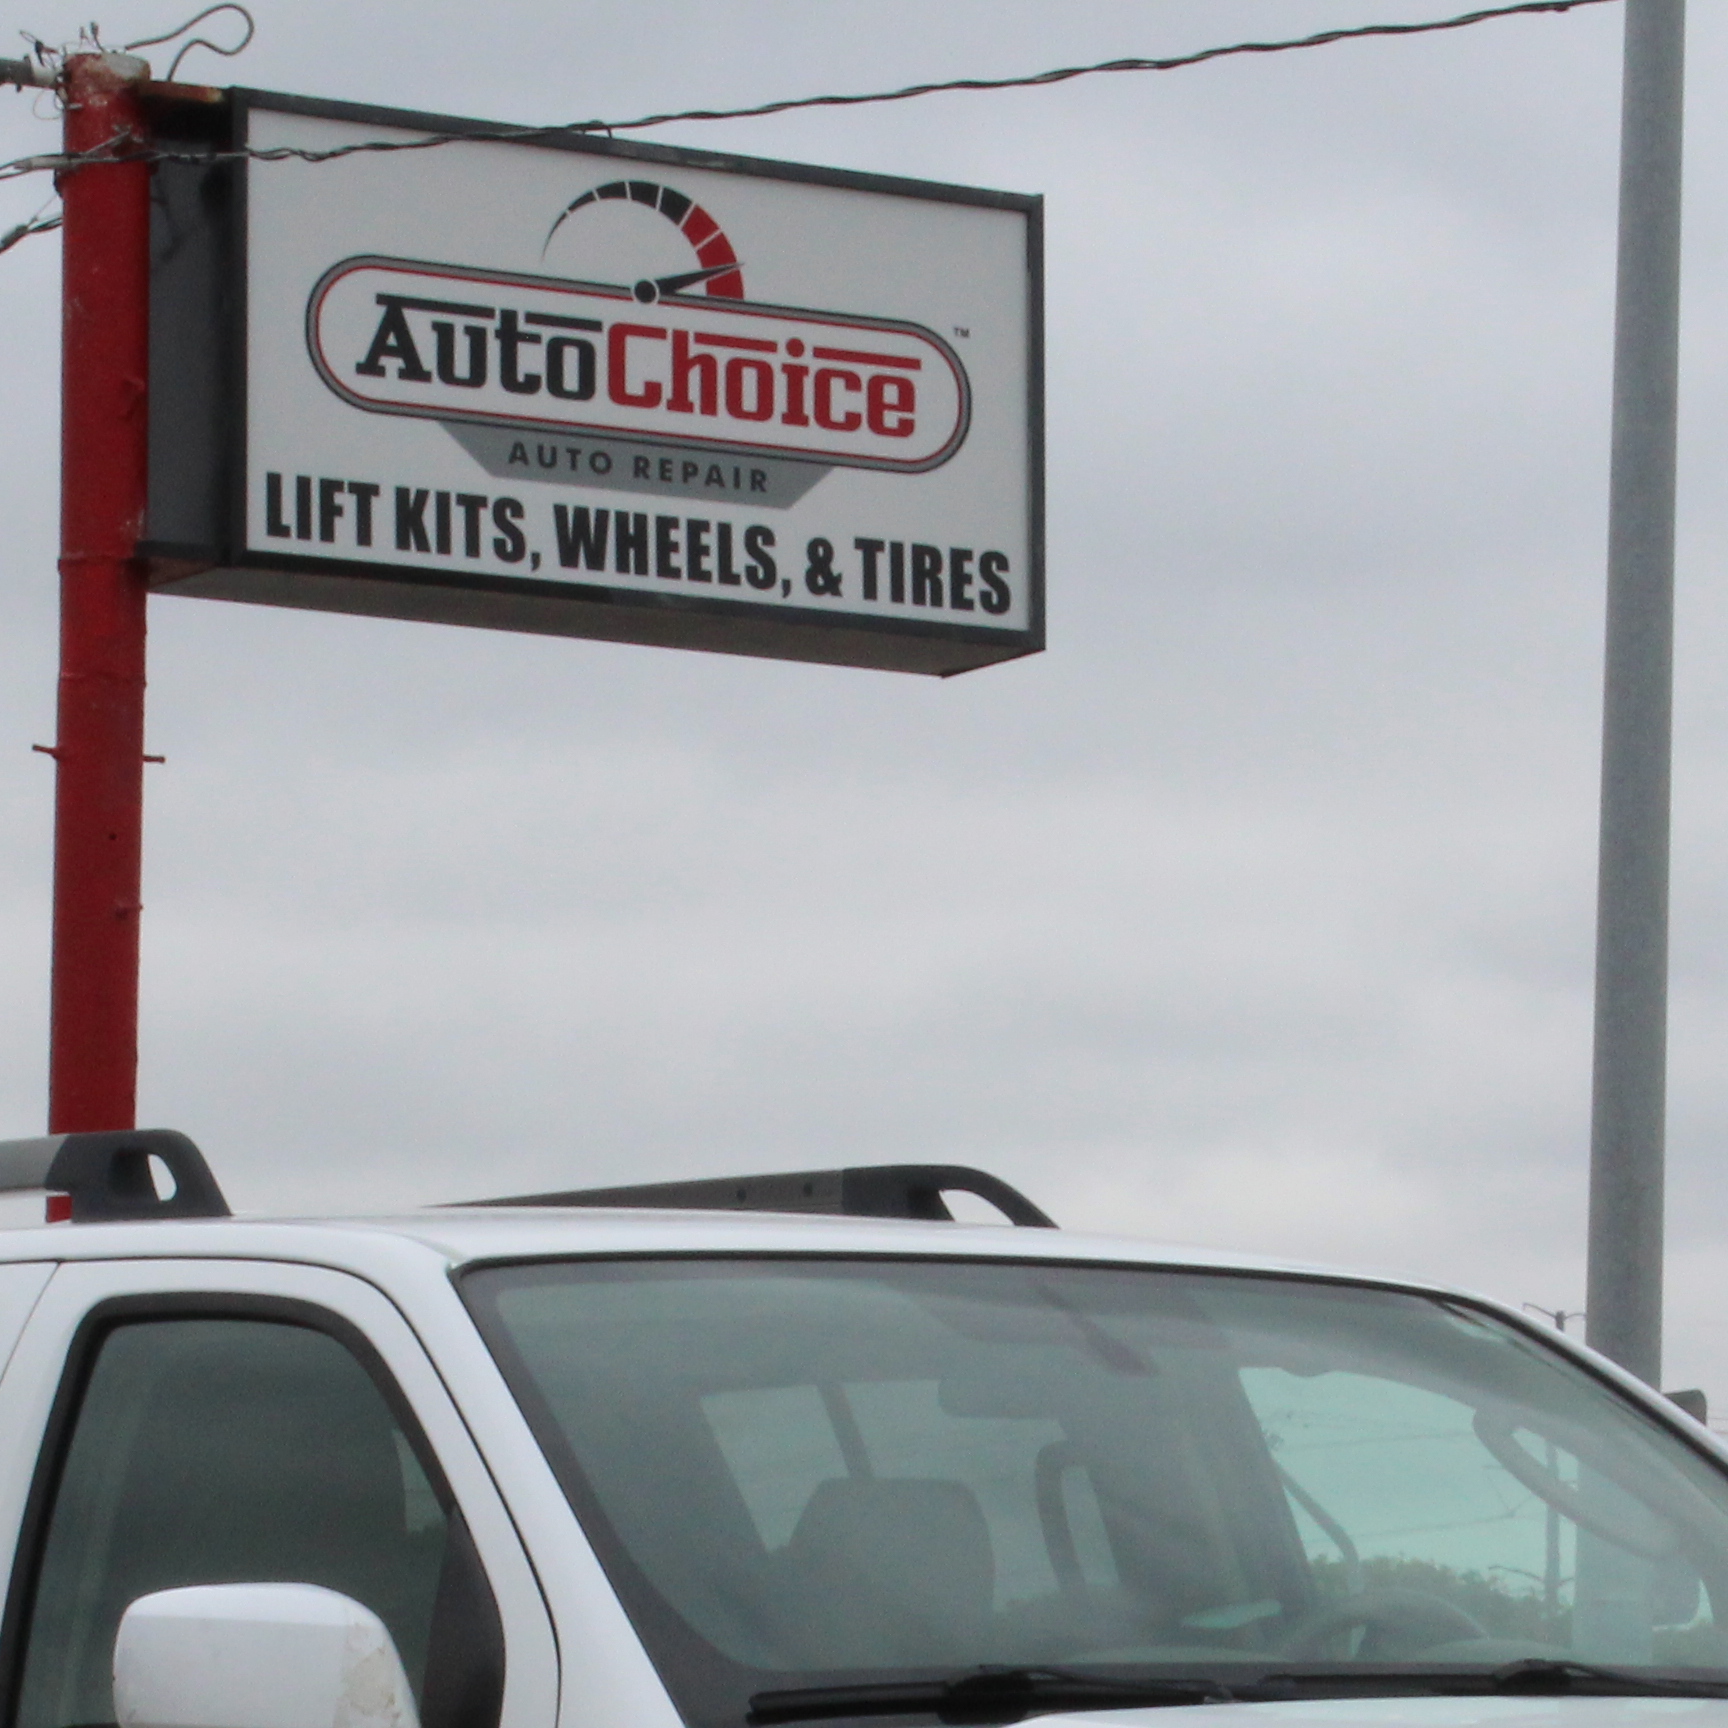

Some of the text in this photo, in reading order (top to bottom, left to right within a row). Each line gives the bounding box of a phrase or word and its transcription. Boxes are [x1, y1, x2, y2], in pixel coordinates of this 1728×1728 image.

[355, 293, 922, 438] AutoChoice
[508, 441, 768, 493] AUTO REPAIR
[266, 471, 1012, 615] LIFT KITS, WHEELS, & TIRES
